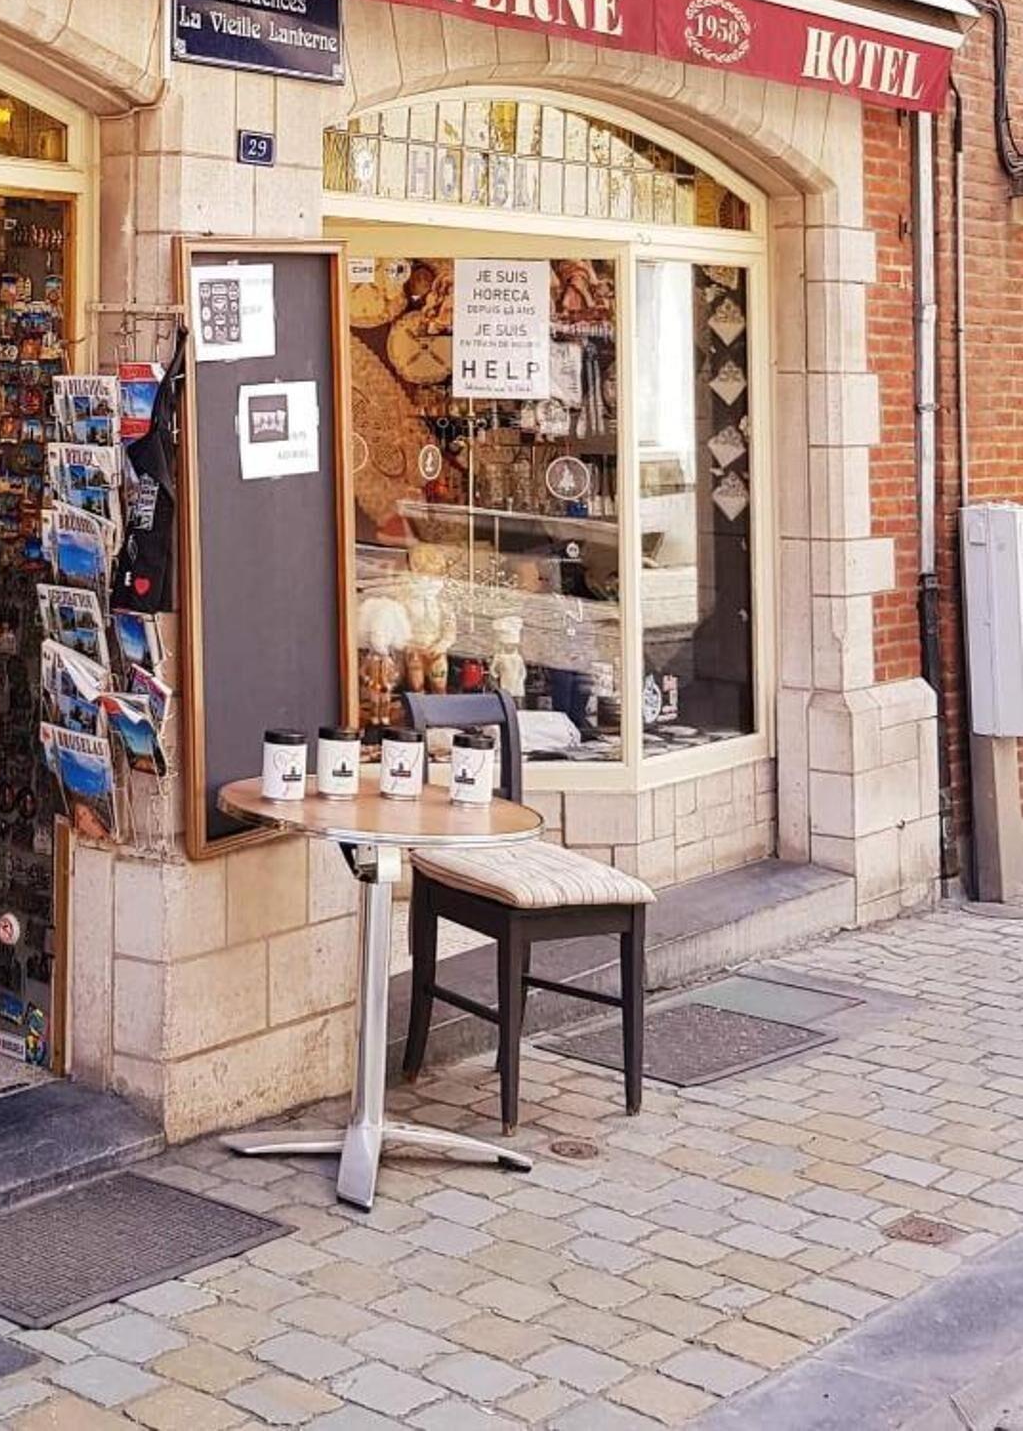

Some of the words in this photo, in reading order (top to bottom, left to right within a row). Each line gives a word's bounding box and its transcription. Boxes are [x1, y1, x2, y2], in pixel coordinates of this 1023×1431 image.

[179, 5, 201, 30] La
[210, 10, 261, 39] Vieille
[269, 20, 338, 52] Lanterne
[695, 12, 740, 44] 1958
[801, 26, 926, 101] HOTEL
[247, 138, 267, 157] 29
[476, 270, 491, 283] JE
[496, 270, 528, 283] SUIS
[473, 288, 530, 302] HORECA
[475, 324, 491, 336] JE
[495, 324, 527, 337] SUIS
[462, 360, 540, 380] HELP
